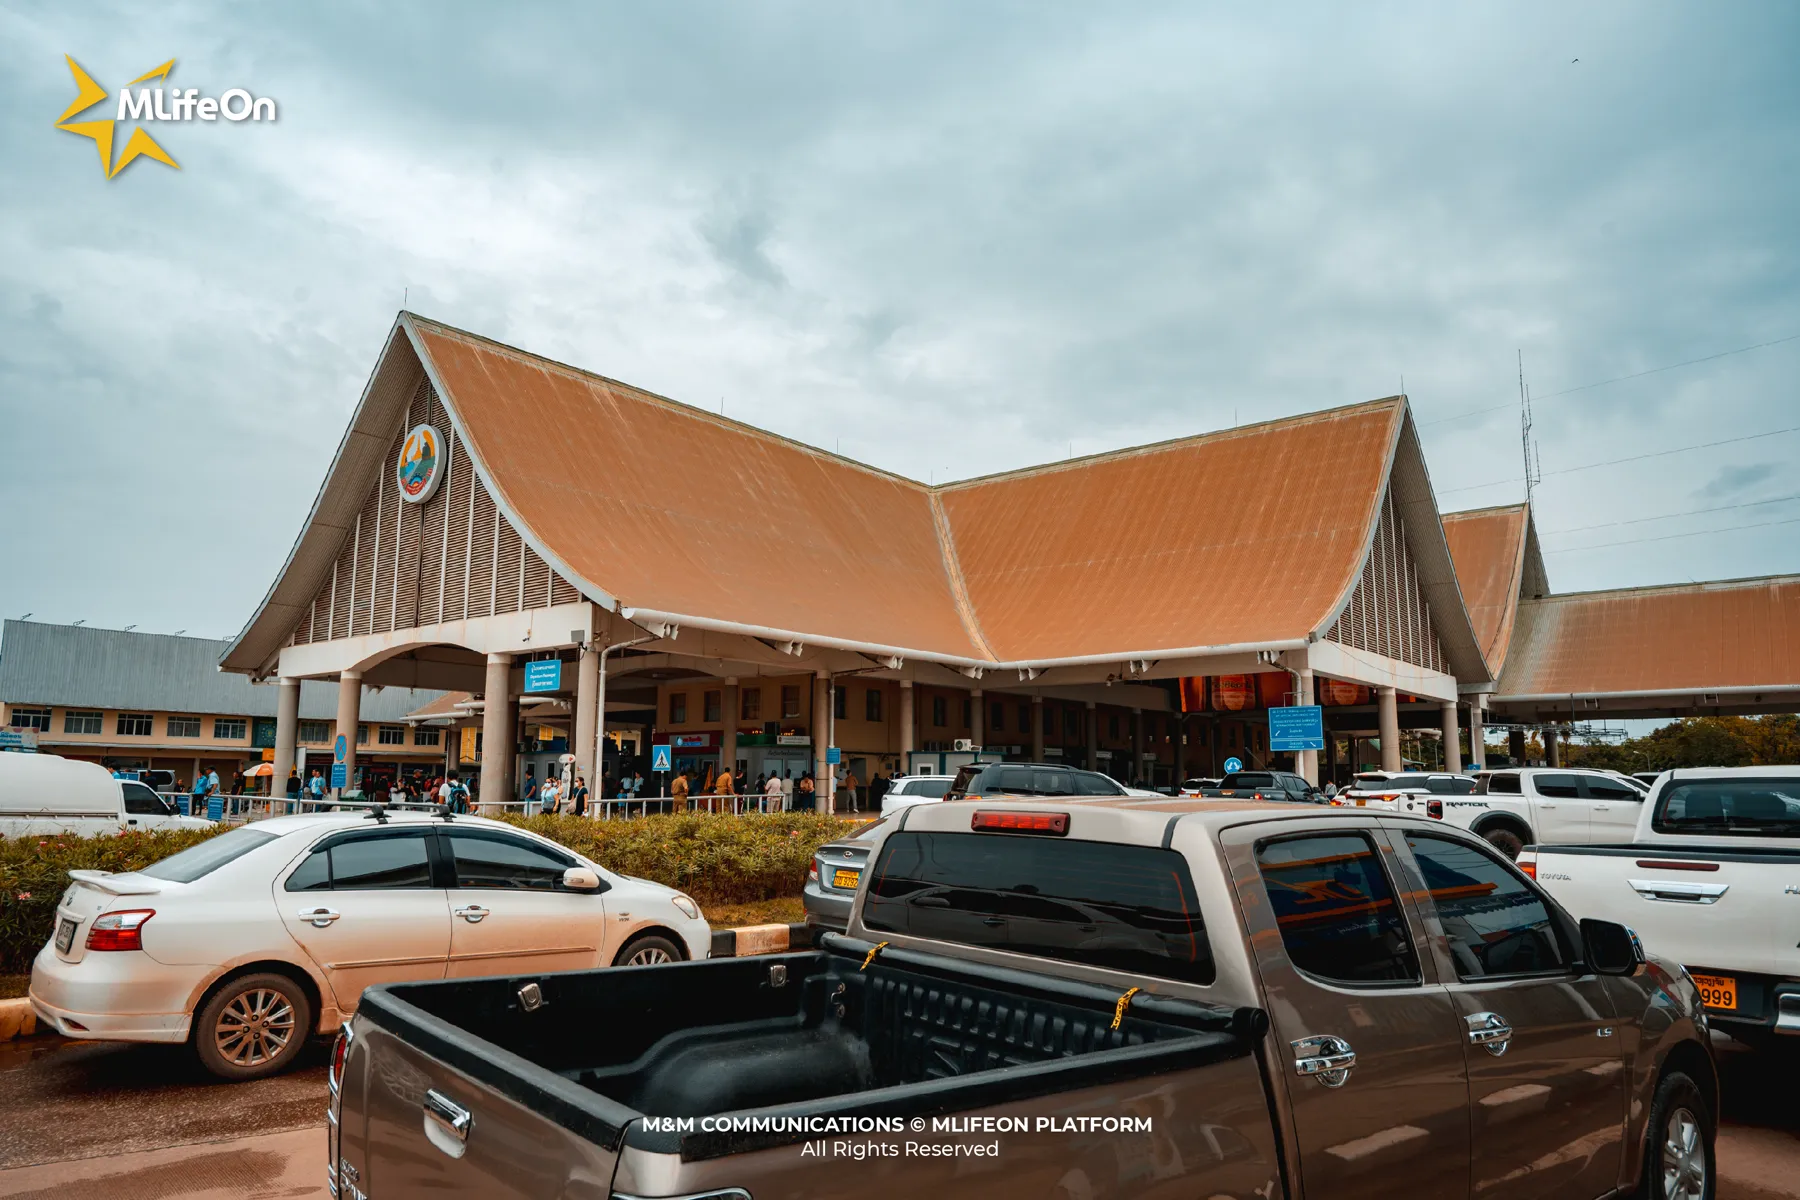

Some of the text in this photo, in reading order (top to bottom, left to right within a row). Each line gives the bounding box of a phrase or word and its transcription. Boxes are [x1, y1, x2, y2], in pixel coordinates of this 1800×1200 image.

[1446, 801, 1491, 810] RAPTOR
[1540, 873, 1572, 881] TOYOTA
[1701, 988, 1733, 1007] 999
